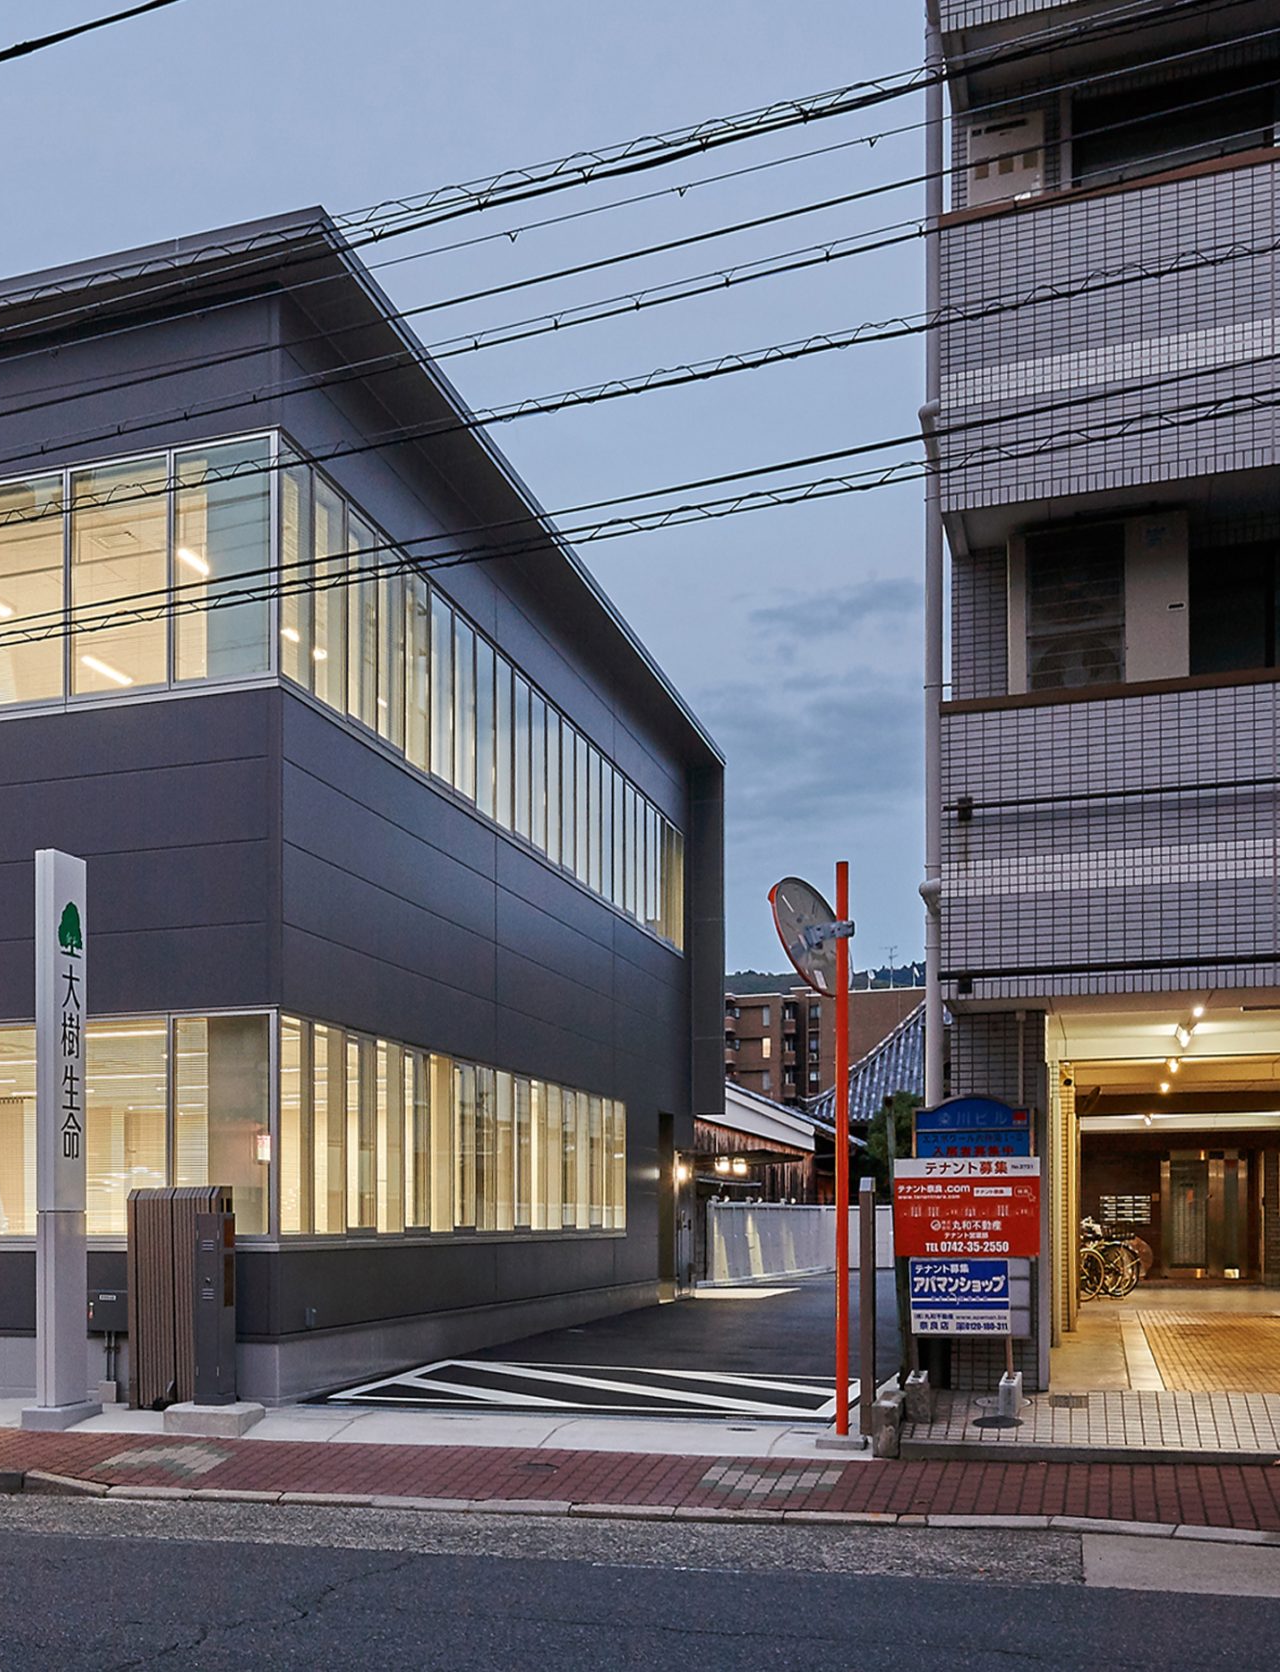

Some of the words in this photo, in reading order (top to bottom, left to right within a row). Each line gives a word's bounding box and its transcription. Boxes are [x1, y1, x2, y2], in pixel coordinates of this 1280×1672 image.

[60, 965, 82, 1160] 大樹生命
[925, 1161, 1008, 1175] テナント募集
[925, 1243, 939, 1253] TEL
[940, 1242, 1009, 1253] 0742-35-2550
[915, 1264, 969, 1274] テナント募集
[913, 1275, 1006, 1293] アパマンショップ
[919, 1321, 949, 1330] 奈良店
